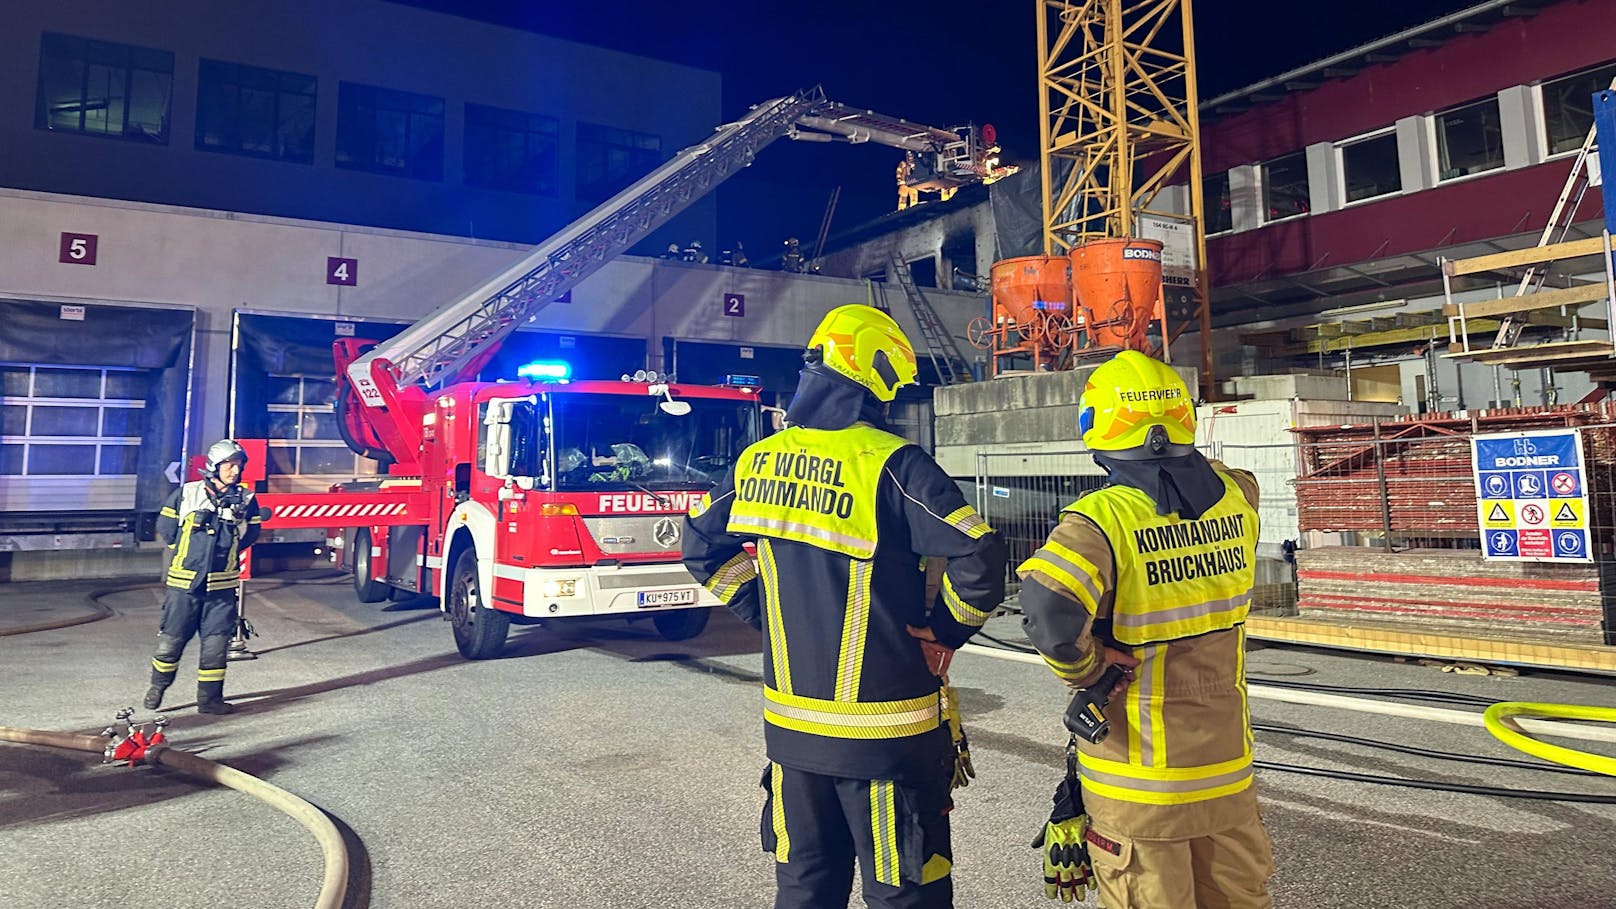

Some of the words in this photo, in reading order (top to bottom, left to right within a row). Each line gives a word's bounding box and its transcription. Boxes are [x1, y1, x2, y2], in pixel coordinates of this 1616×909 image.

[69, 238, 87, 259] 5
[333, 262, 349, 281] 4
[729, 298, 739, 313] 2
[362, 387, 380, 398] 122
[1120, 388, 1182, 401] FEUERWEHR
[774, 448, 845, 488] WÖRGL
[1495, 455, 1559, 467] BODNER
[600, 494, 706, 512] FEUERWE
[1133, 514, 1244, 554] KOMMANDANT
[1145, 545, 1247, 586] BRUCKHÄUSL
[646, 593, 657, 604] KU
[662, 592, 679, 602] 975
